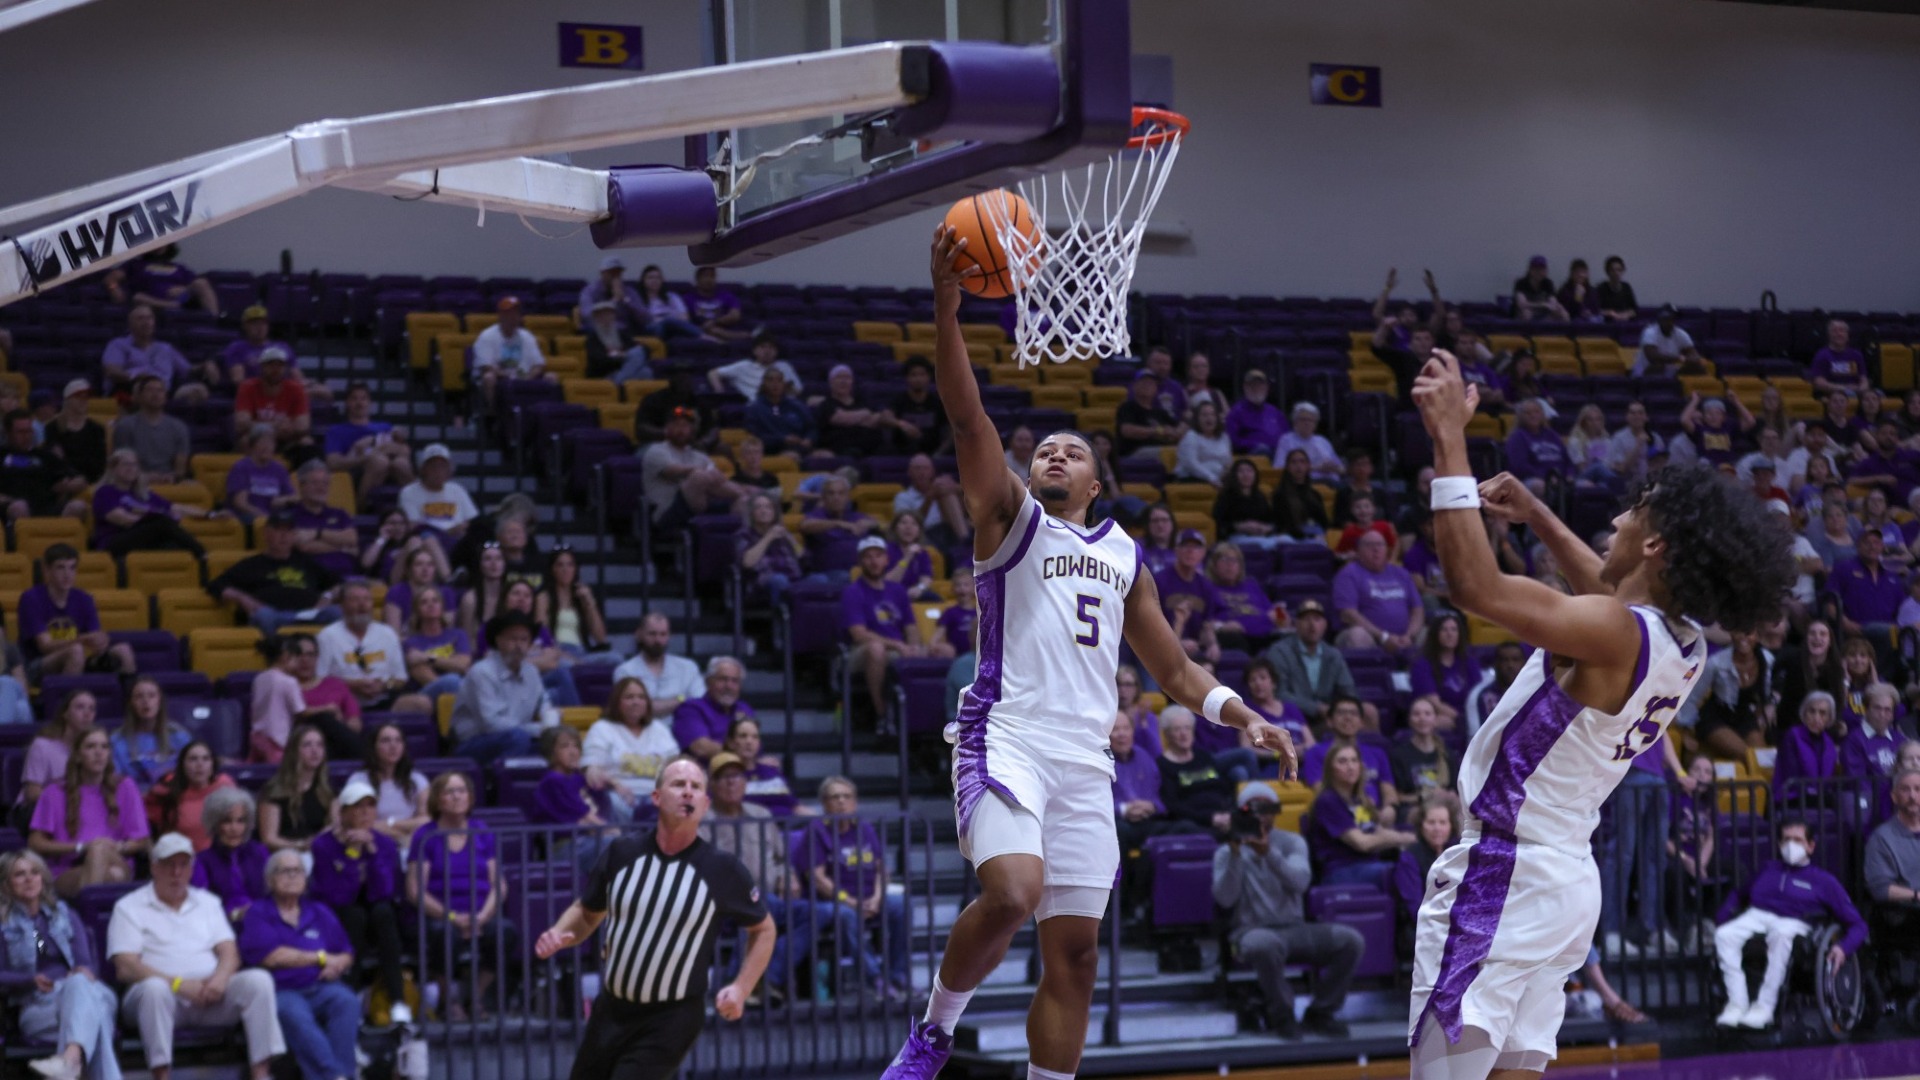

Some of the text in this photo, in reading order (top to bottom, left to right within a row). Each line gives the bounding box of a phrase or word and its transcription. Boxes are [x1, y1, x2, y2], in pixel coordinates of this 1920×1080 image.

[575, 28, 628, 64] B
[1327, 69, 1366, 102] C
[1075, 592, 1102, 648] 5
[1611, 695, 1681, 761] 15
